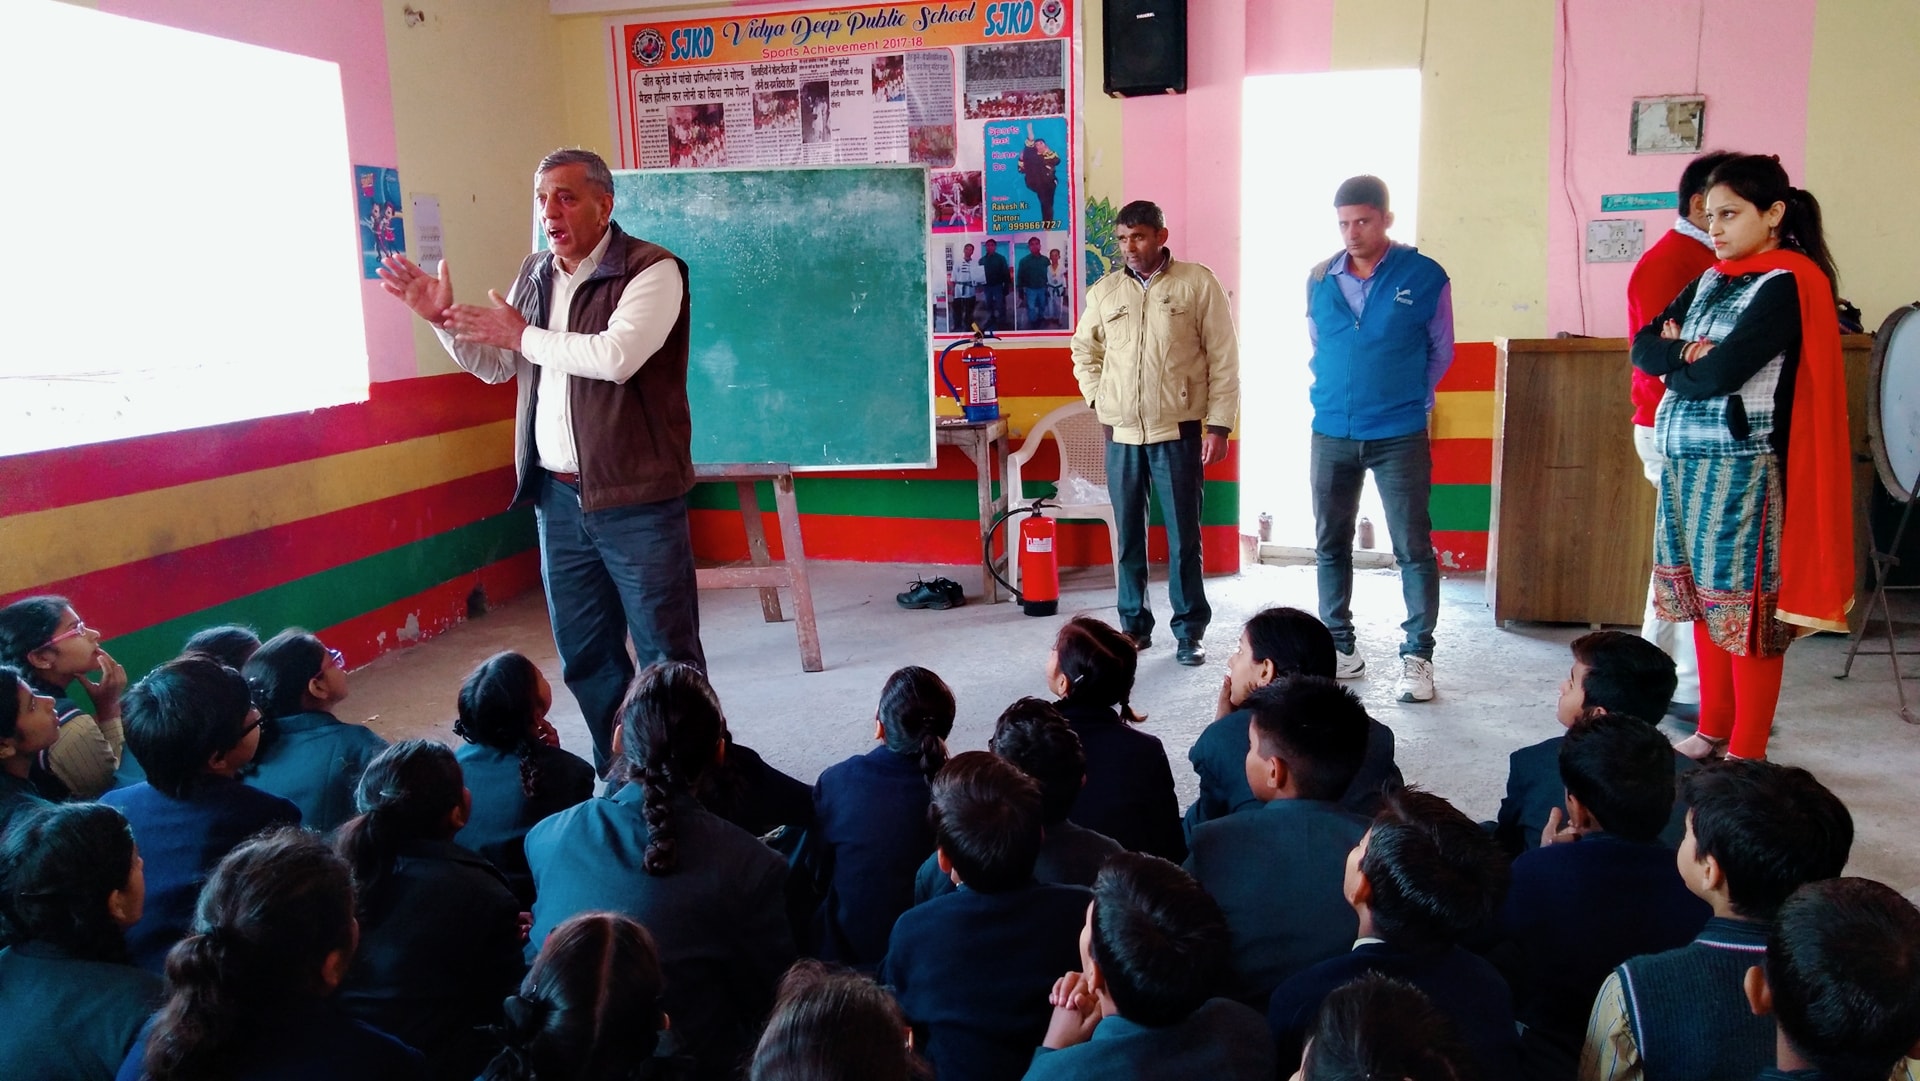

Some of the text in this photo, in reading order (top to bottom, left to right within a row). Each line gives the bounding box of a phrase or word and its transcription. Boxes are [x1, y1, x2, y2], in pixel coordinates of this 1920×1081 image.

[722, 2, 976, 45] Vidya Deep Public School
[985, 1, 1034, 36] SJKD
[671, 27, 714, 60] SJKD
[762, 37, 923, 59] Sports Achievement 2017-18
[992, 202, 1017, 210] Rakesh
[1008, 220, 1061, 231] 9999667727
